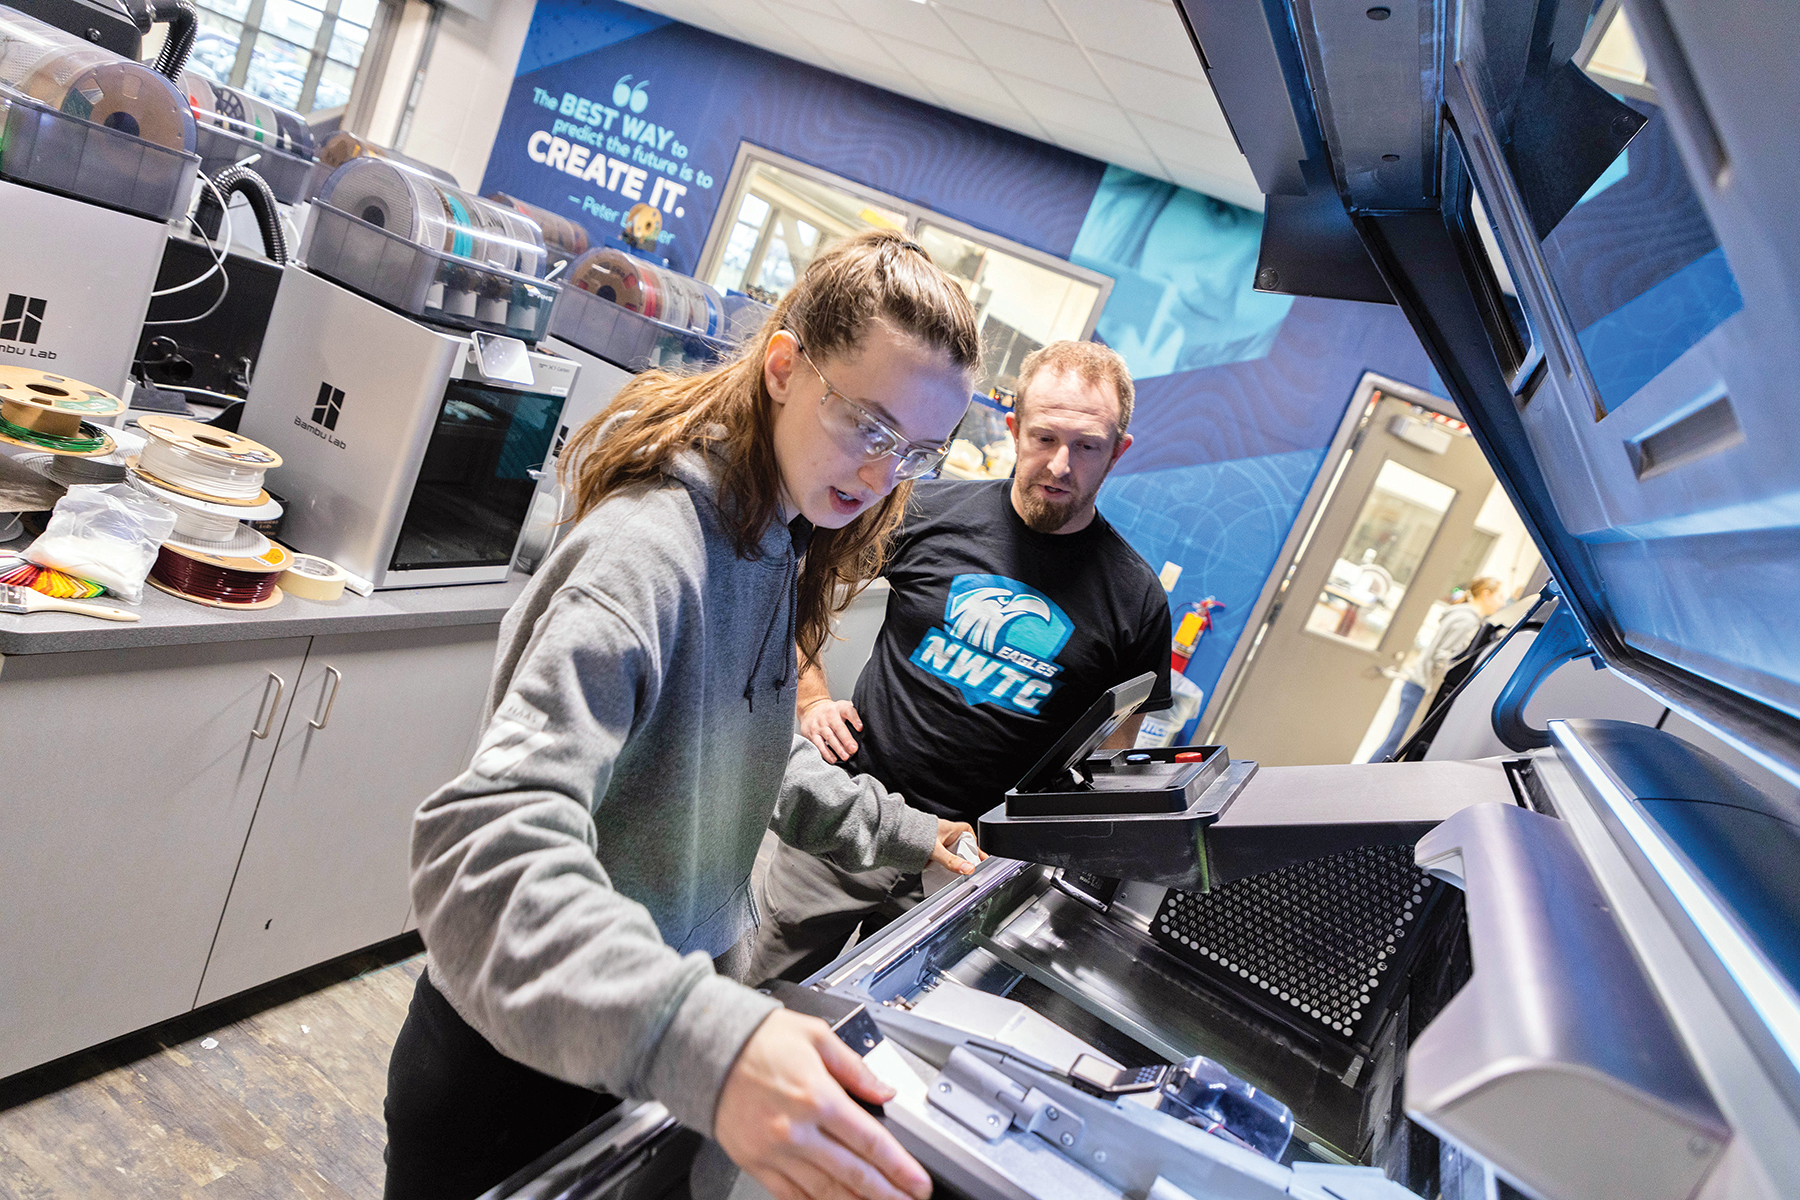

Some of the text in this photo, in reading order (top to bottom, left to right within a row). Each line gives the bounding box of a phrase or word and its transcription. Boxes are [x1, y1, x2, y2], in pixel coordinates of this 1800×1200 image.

[532, 86, 689, 159] The BEST WAY to
[527, 130, 688, 218] CREATE IT.
[551, 117, 714, 189] predict the future is to
[581, 194, 620, 223] Peter
[29, 347, 57, 360] Lab
[293, 415, 347, 450] Bambu Lab
[919, 634, 1053, 710] NWTC
[995, 645, 1059, 678] EAGLES
